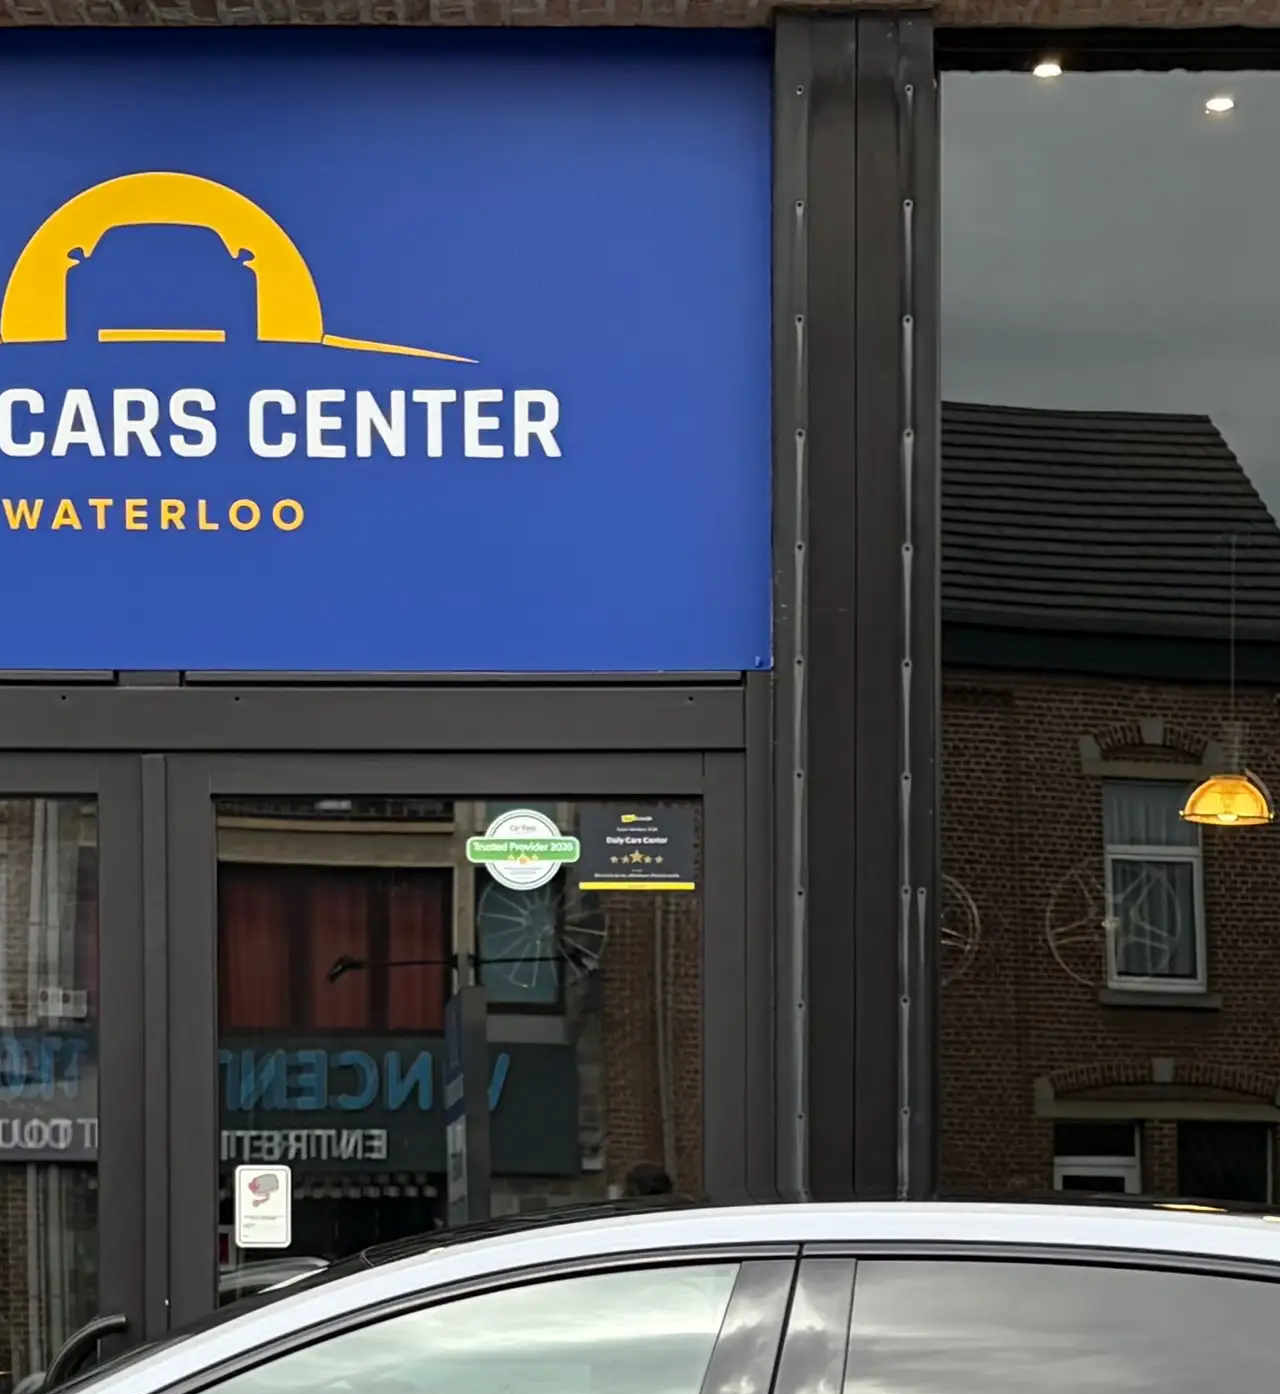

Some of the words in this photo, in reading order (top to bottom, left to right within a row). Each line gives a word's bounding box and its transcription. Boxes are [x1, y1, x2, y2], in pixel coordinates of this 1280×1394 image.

[249, 389, 561, 458] CENTER
[2, 498, 304, 531] WATERLOO
[472, 841, 508, 852] Trusted
[508, 841, 548, 852] Provider
[605, 836, 624, 846] Daily
[624, 836, 642, 845] Cars
[643, 836, 669, 845] Center
